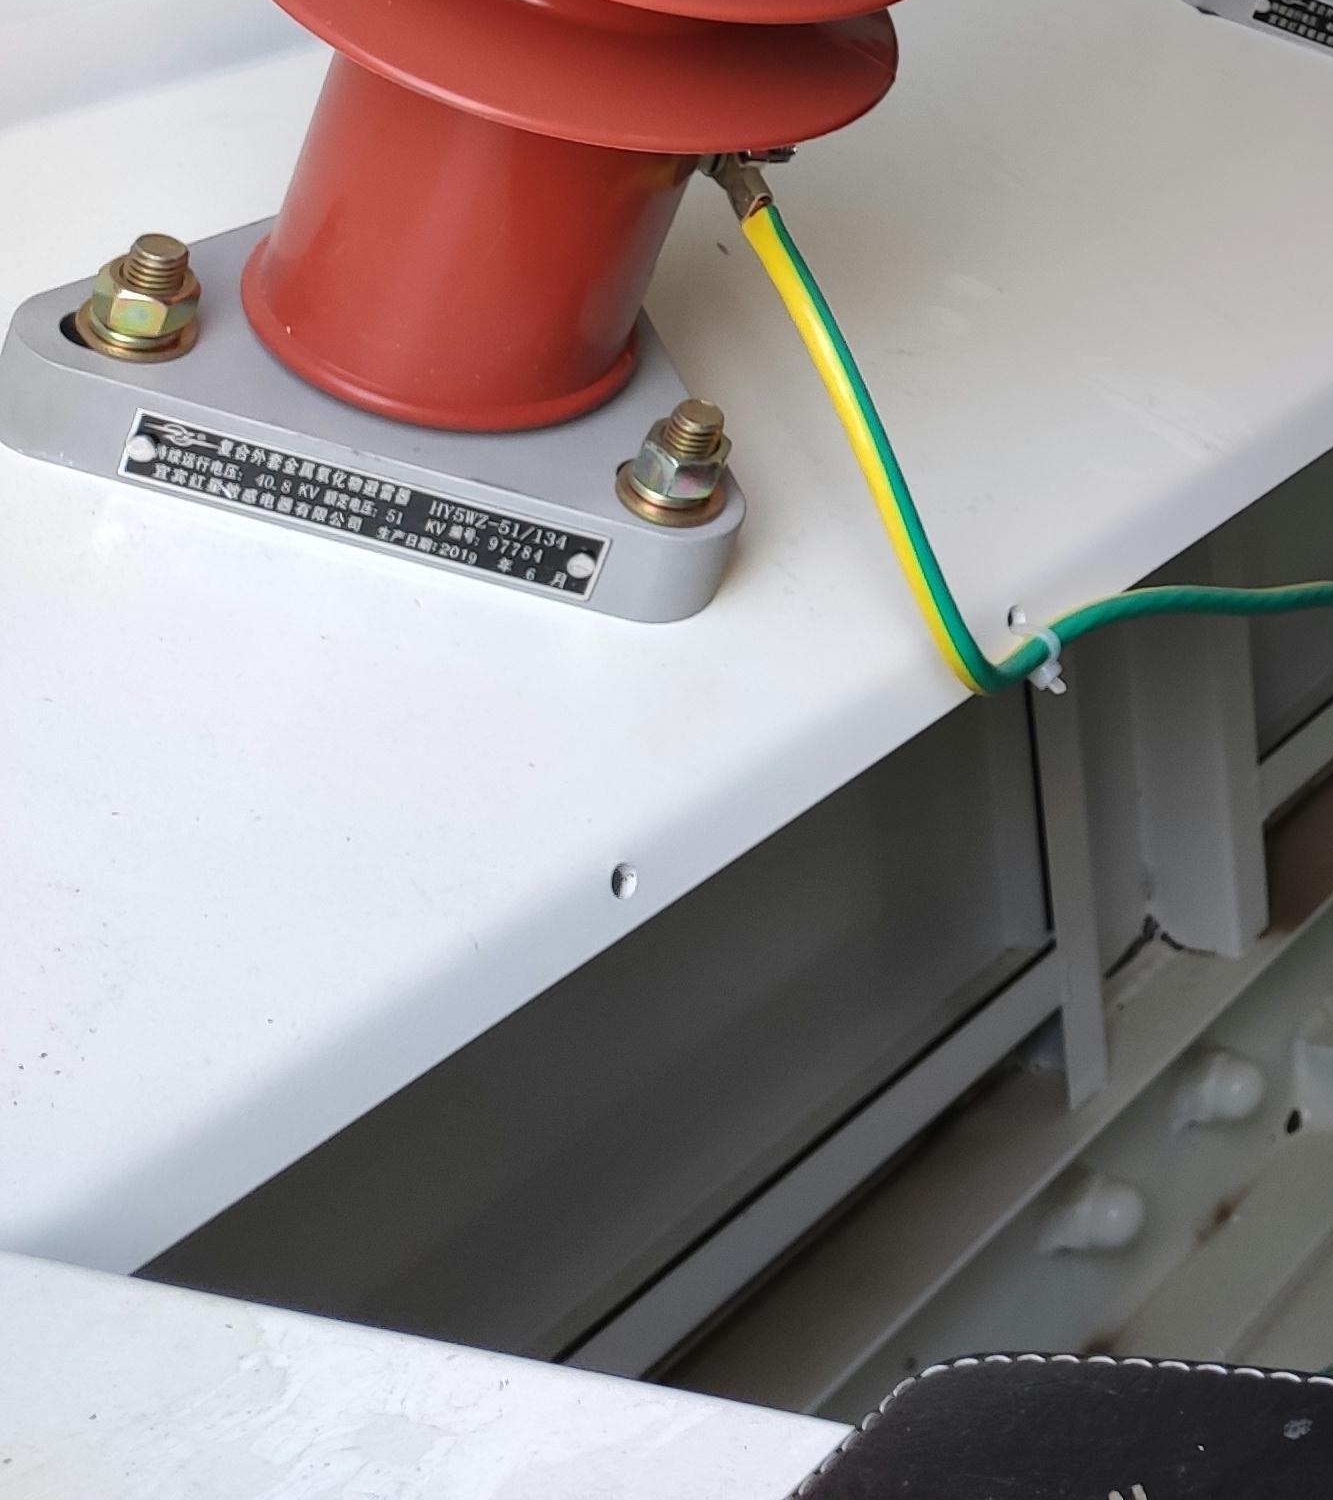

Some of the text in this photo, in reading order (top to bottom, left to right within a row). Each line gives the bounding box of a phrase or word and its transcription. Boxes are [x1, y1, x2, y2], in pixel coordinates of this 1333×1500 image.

[424, 518, 447, 536] KV
[487, 535, 544, 564] 97784
[428, 500, 568, 550] HY5WZ-51/134
[551, 570, 568, 589] 月
